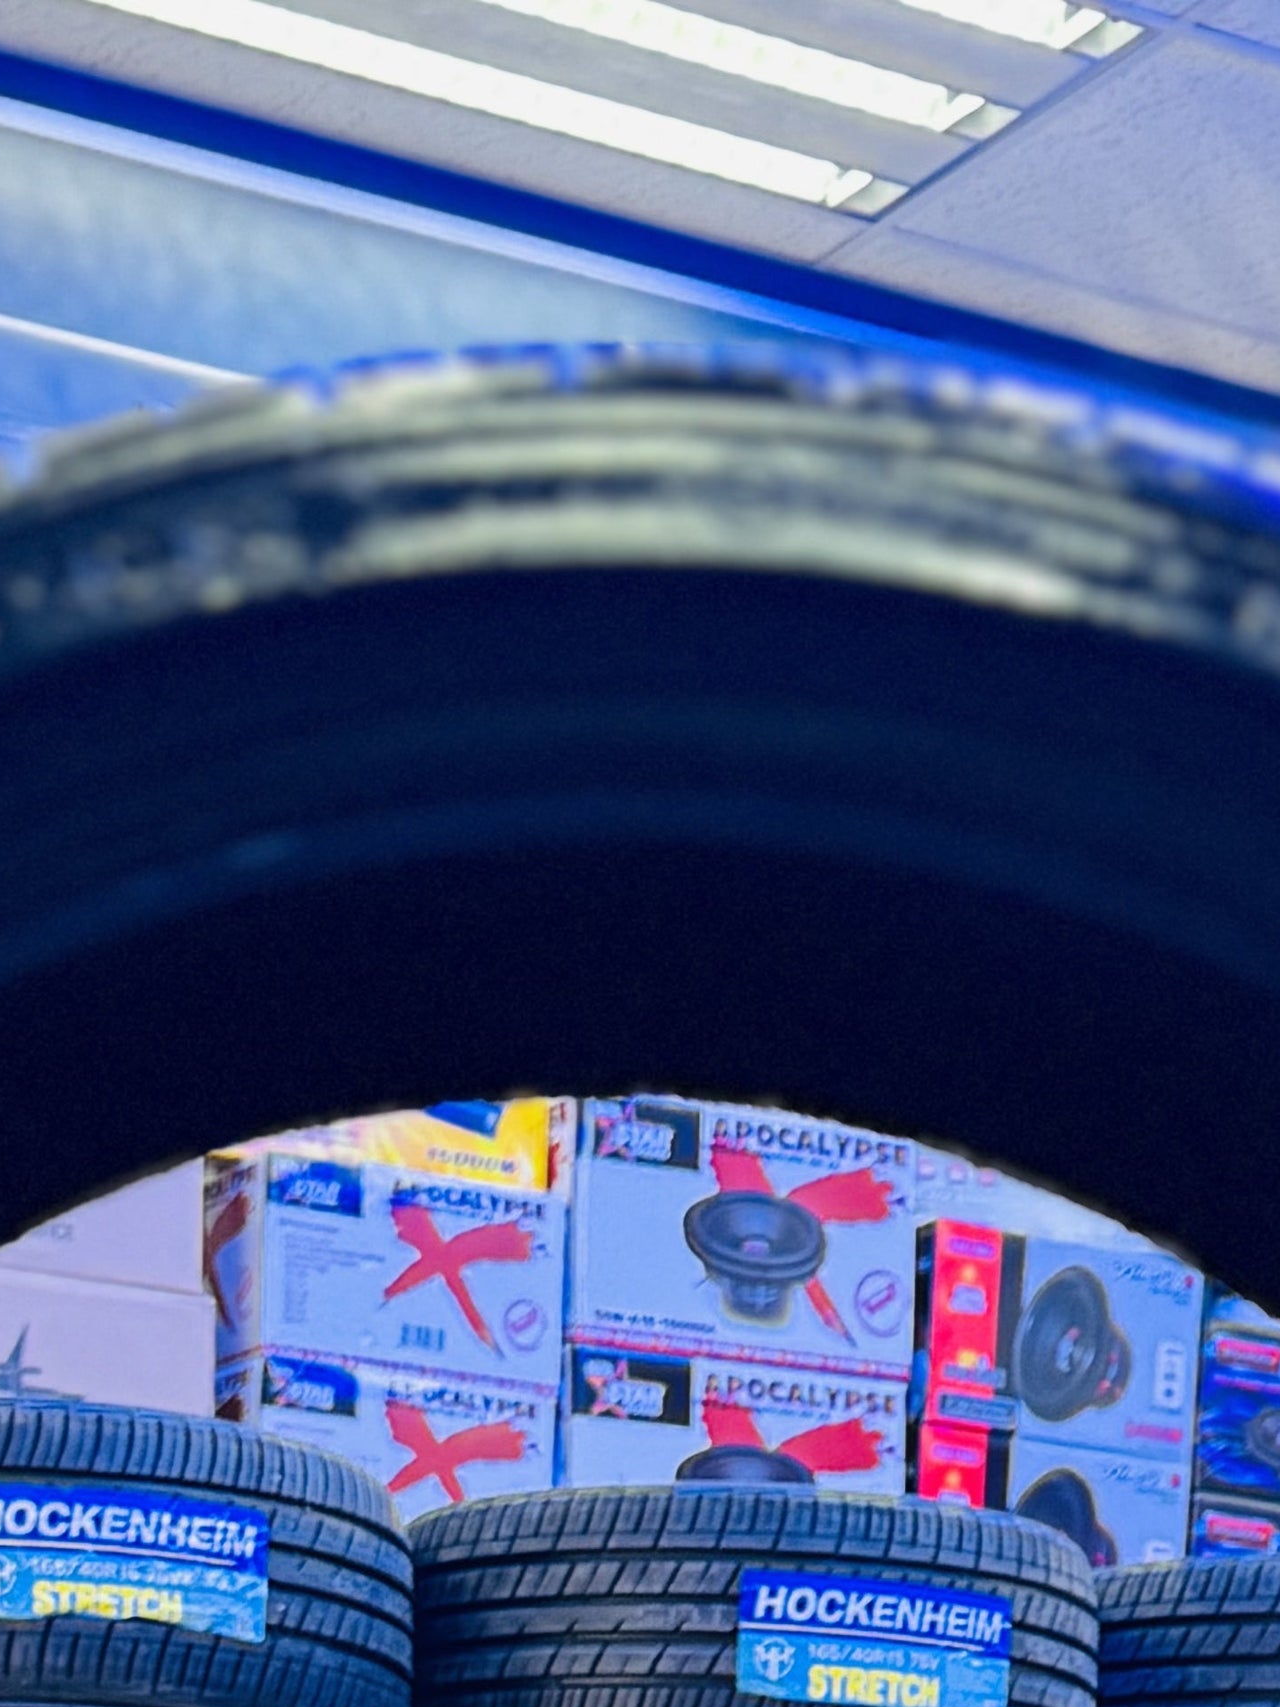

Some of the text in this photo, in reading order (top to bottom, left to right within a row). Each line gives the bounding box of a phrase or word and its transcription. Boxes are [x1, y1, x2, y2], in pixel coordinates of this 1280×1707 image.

[32, 1580, 183, 1624] STRETCH
[754, 1585, 1004, 1644] HOCKENHEIM
[807, 1665, 940, 1707] STRETCH
